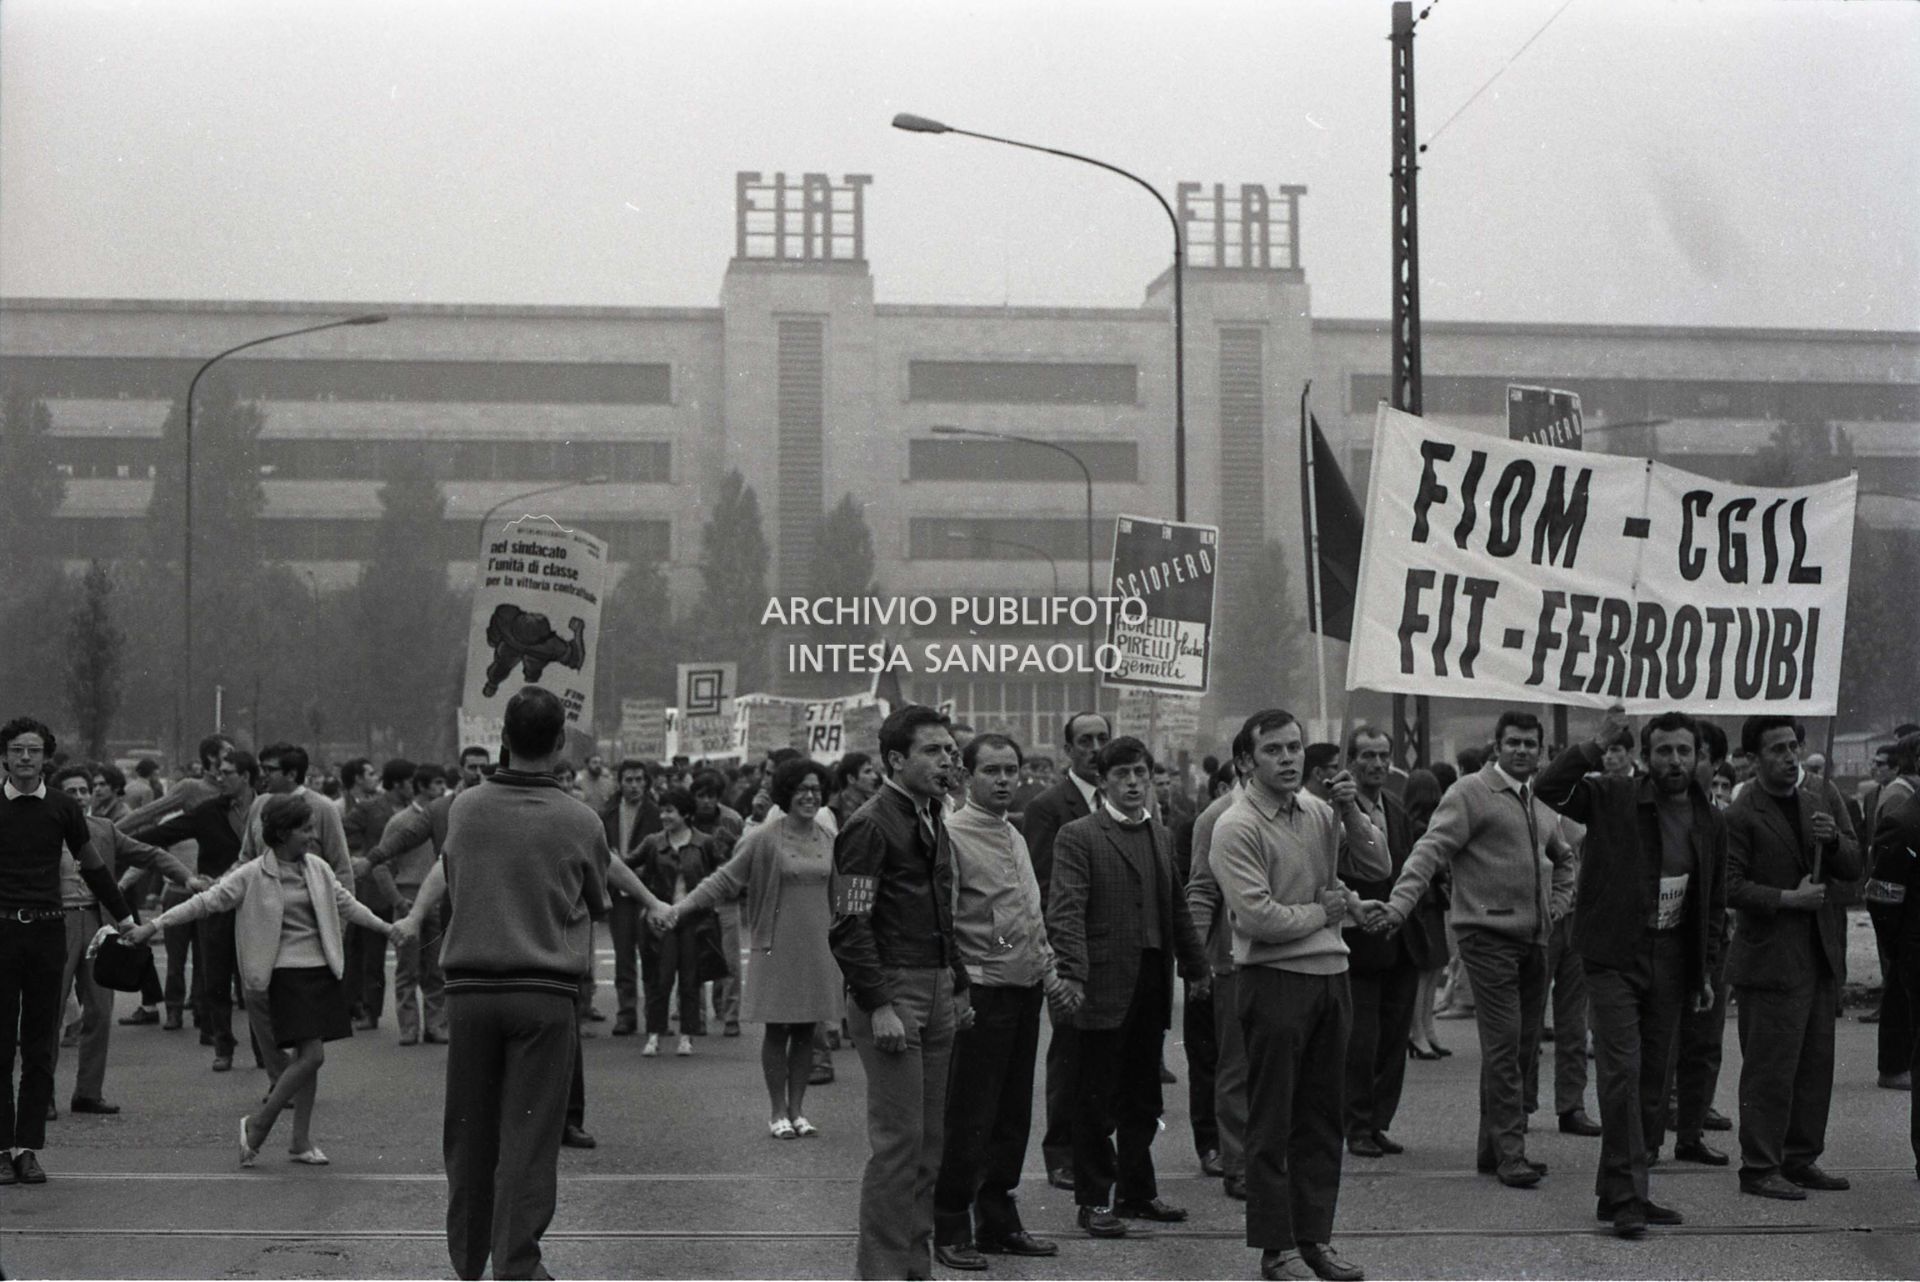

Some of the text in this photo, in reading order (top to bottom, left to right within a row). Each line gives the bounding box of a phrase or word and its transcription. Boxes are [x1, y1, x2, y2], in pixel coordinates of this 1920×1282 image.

[736, 172, 873, 258] FIAT
[1177, 182, 1307, 268] FIAT
[1410, 440, 1593, 569] FIOM
[1678, 489, 1822, 585] CGIL
[490, 540, 508, 554] nel
[511, 541, 567, 559] sindacato
[528, 559, 539, 574] di
[543, 562, 578, 580] classe
[1116, 550, 1212, 602] SCIOPERO
[485, 576, 500, 588] per
[504, 575, 513, 586] la
[516, 577, 551, 591] vittoria
[1117, 634, 1171, 660] PIRELLI
[564, 688, 585, 702] FIM
[852, 878, 873, 889] FIM
